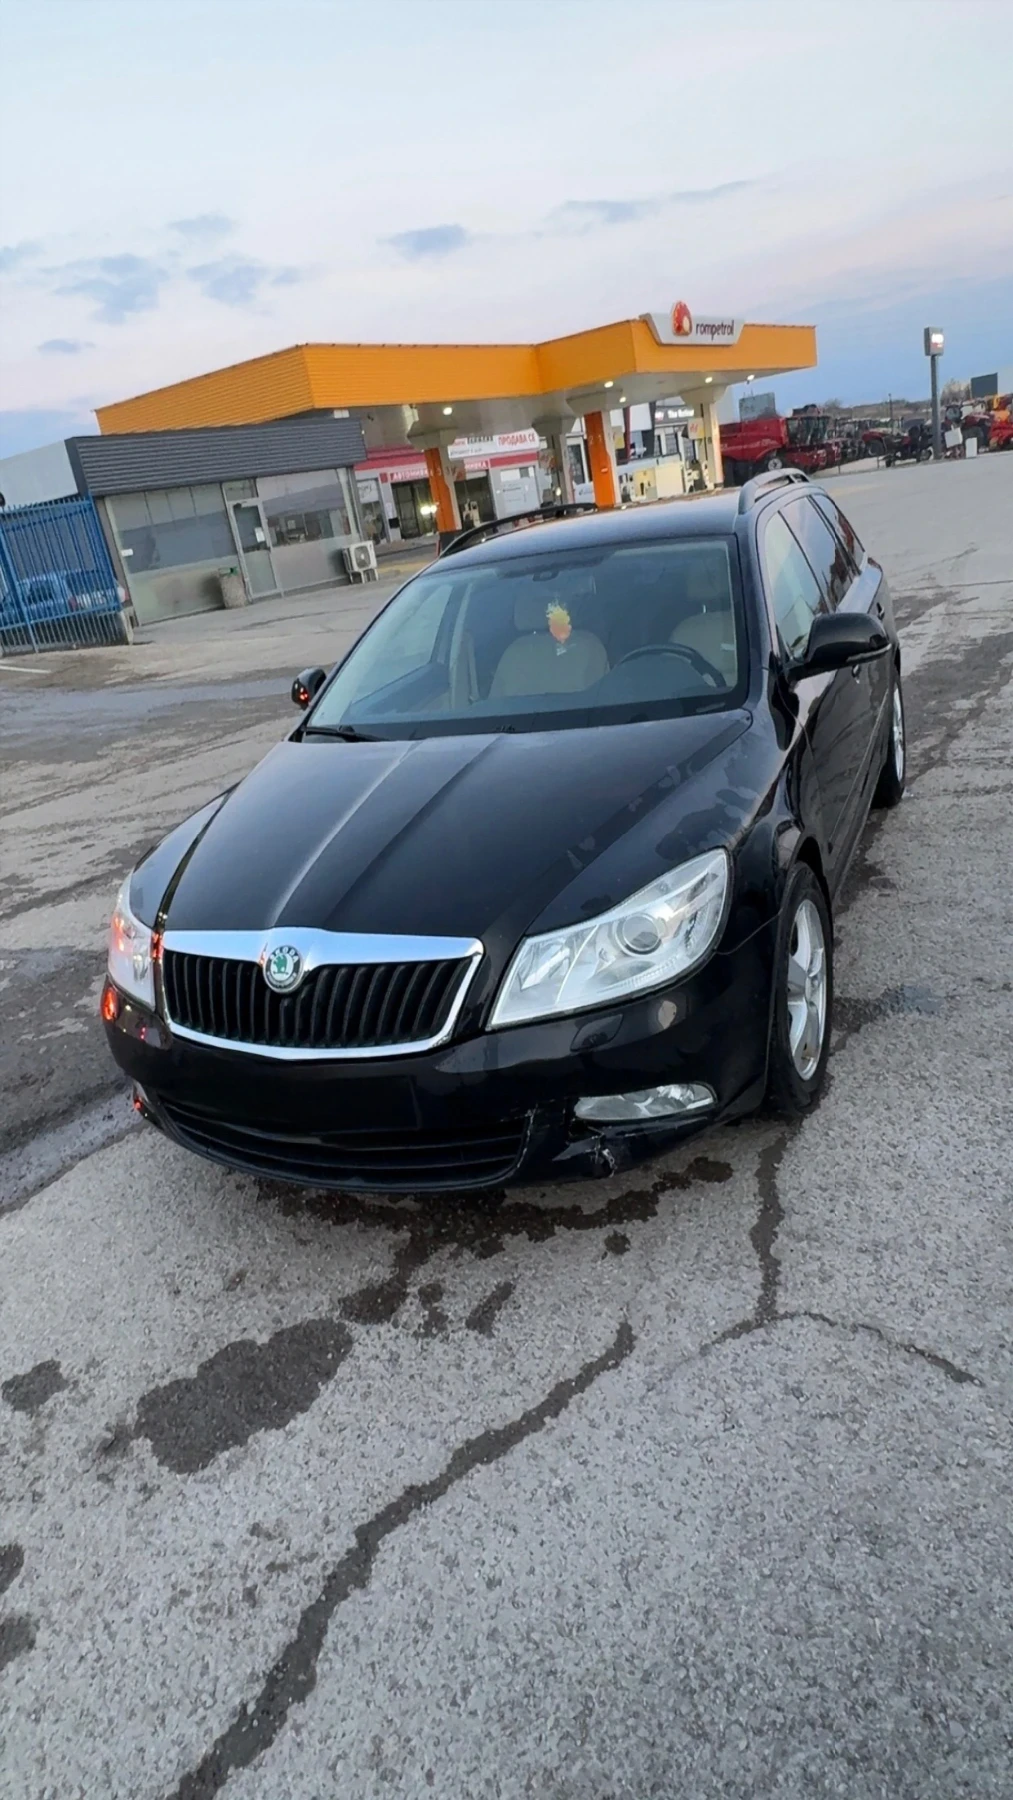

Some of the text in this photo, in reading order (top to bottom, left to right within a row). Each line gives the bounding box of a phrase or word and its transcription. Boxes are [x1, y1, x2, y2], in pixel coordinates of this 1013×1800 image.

[695, 320, 735, 341] rompetrol
[498, 433, 527, 447] ПРОДАВА
[528, 432, 536, 442] СЕ
[393, 468, 429, 481] АВТОМИВК
